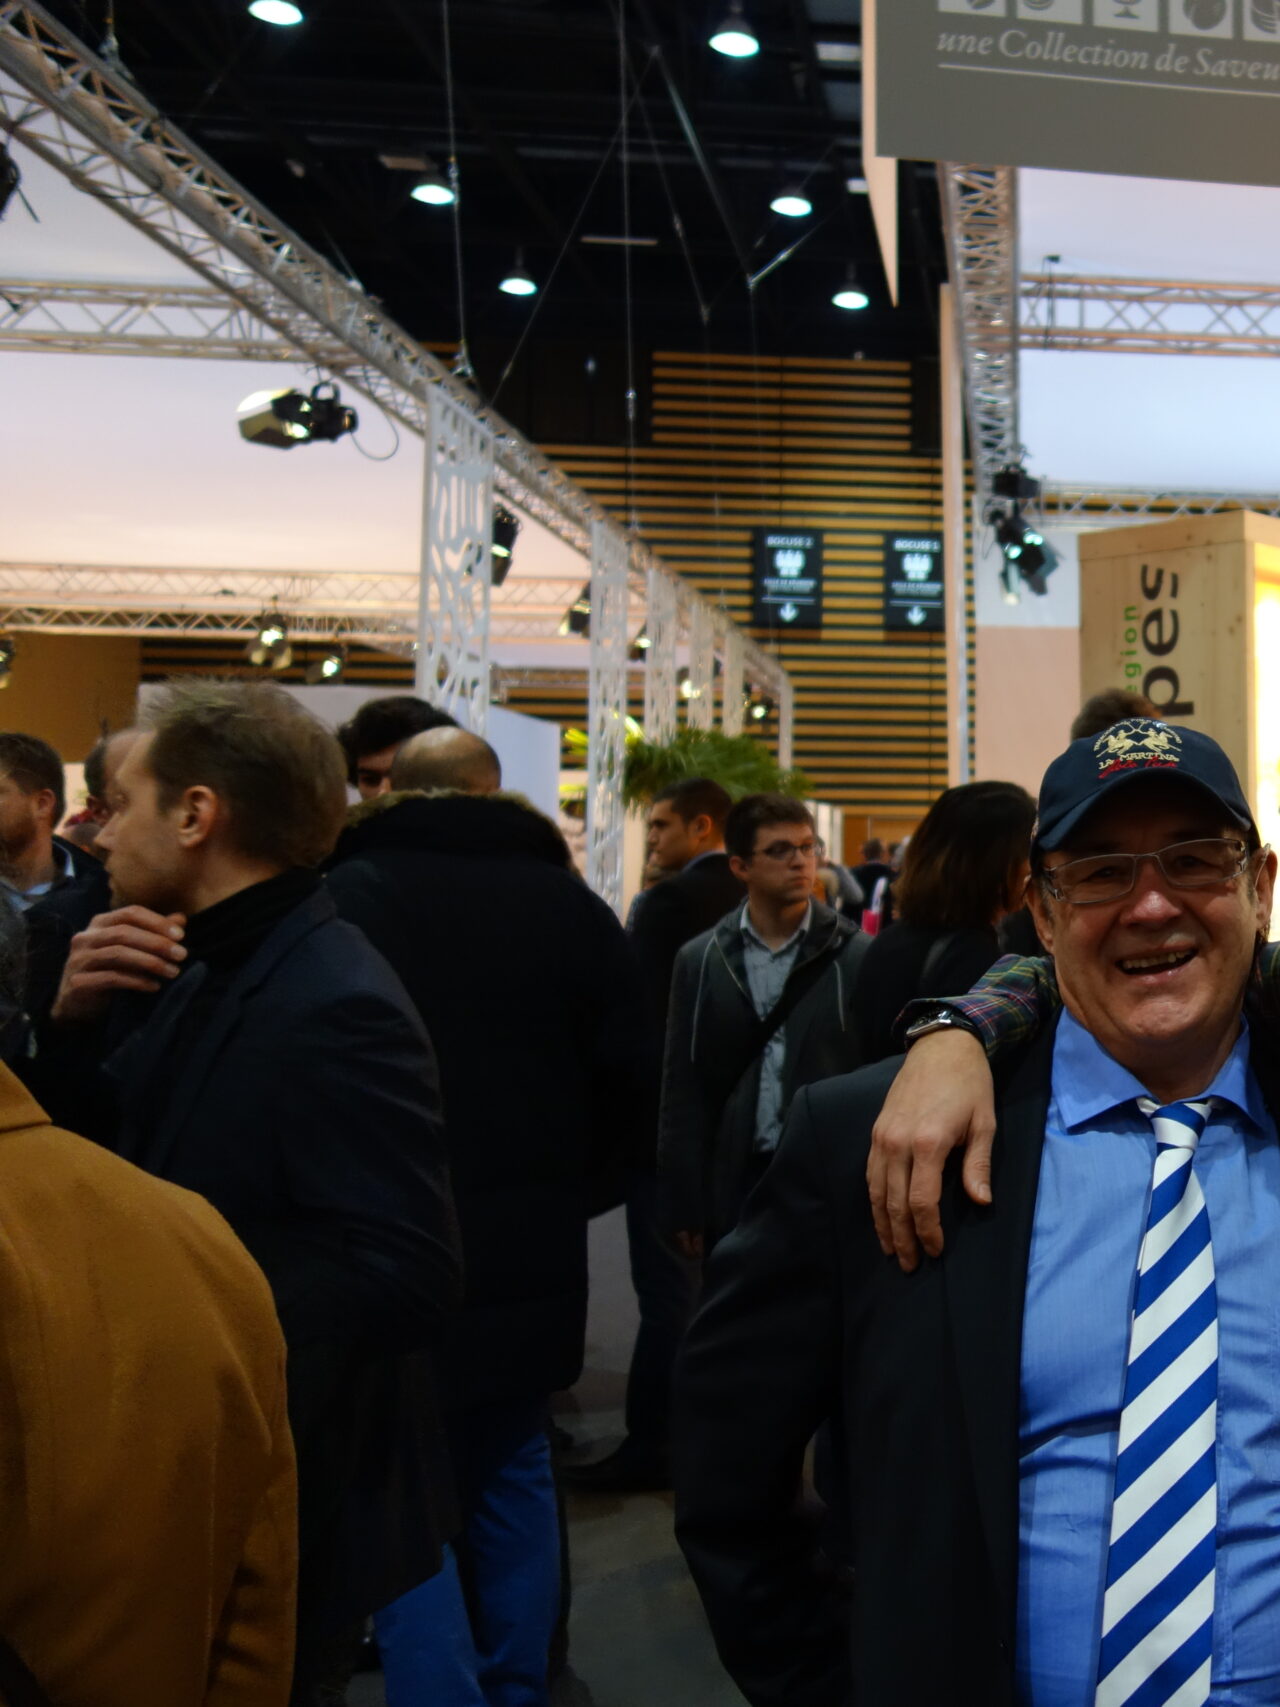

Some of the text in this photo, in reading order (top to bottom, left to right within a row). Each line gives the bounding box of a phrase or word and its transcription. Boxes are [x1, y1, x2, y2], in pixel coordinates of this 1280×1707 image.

[937, 29, 993, 55] une
[999, 29, 1148, 72] Collection
[1155, 43, 1190, 73] de
[766, 536, 813, 548] BOCUSE 2
[894, 540, 931, 551] BOCUSE
[1120, 752, 1180, 762] MARTINA
